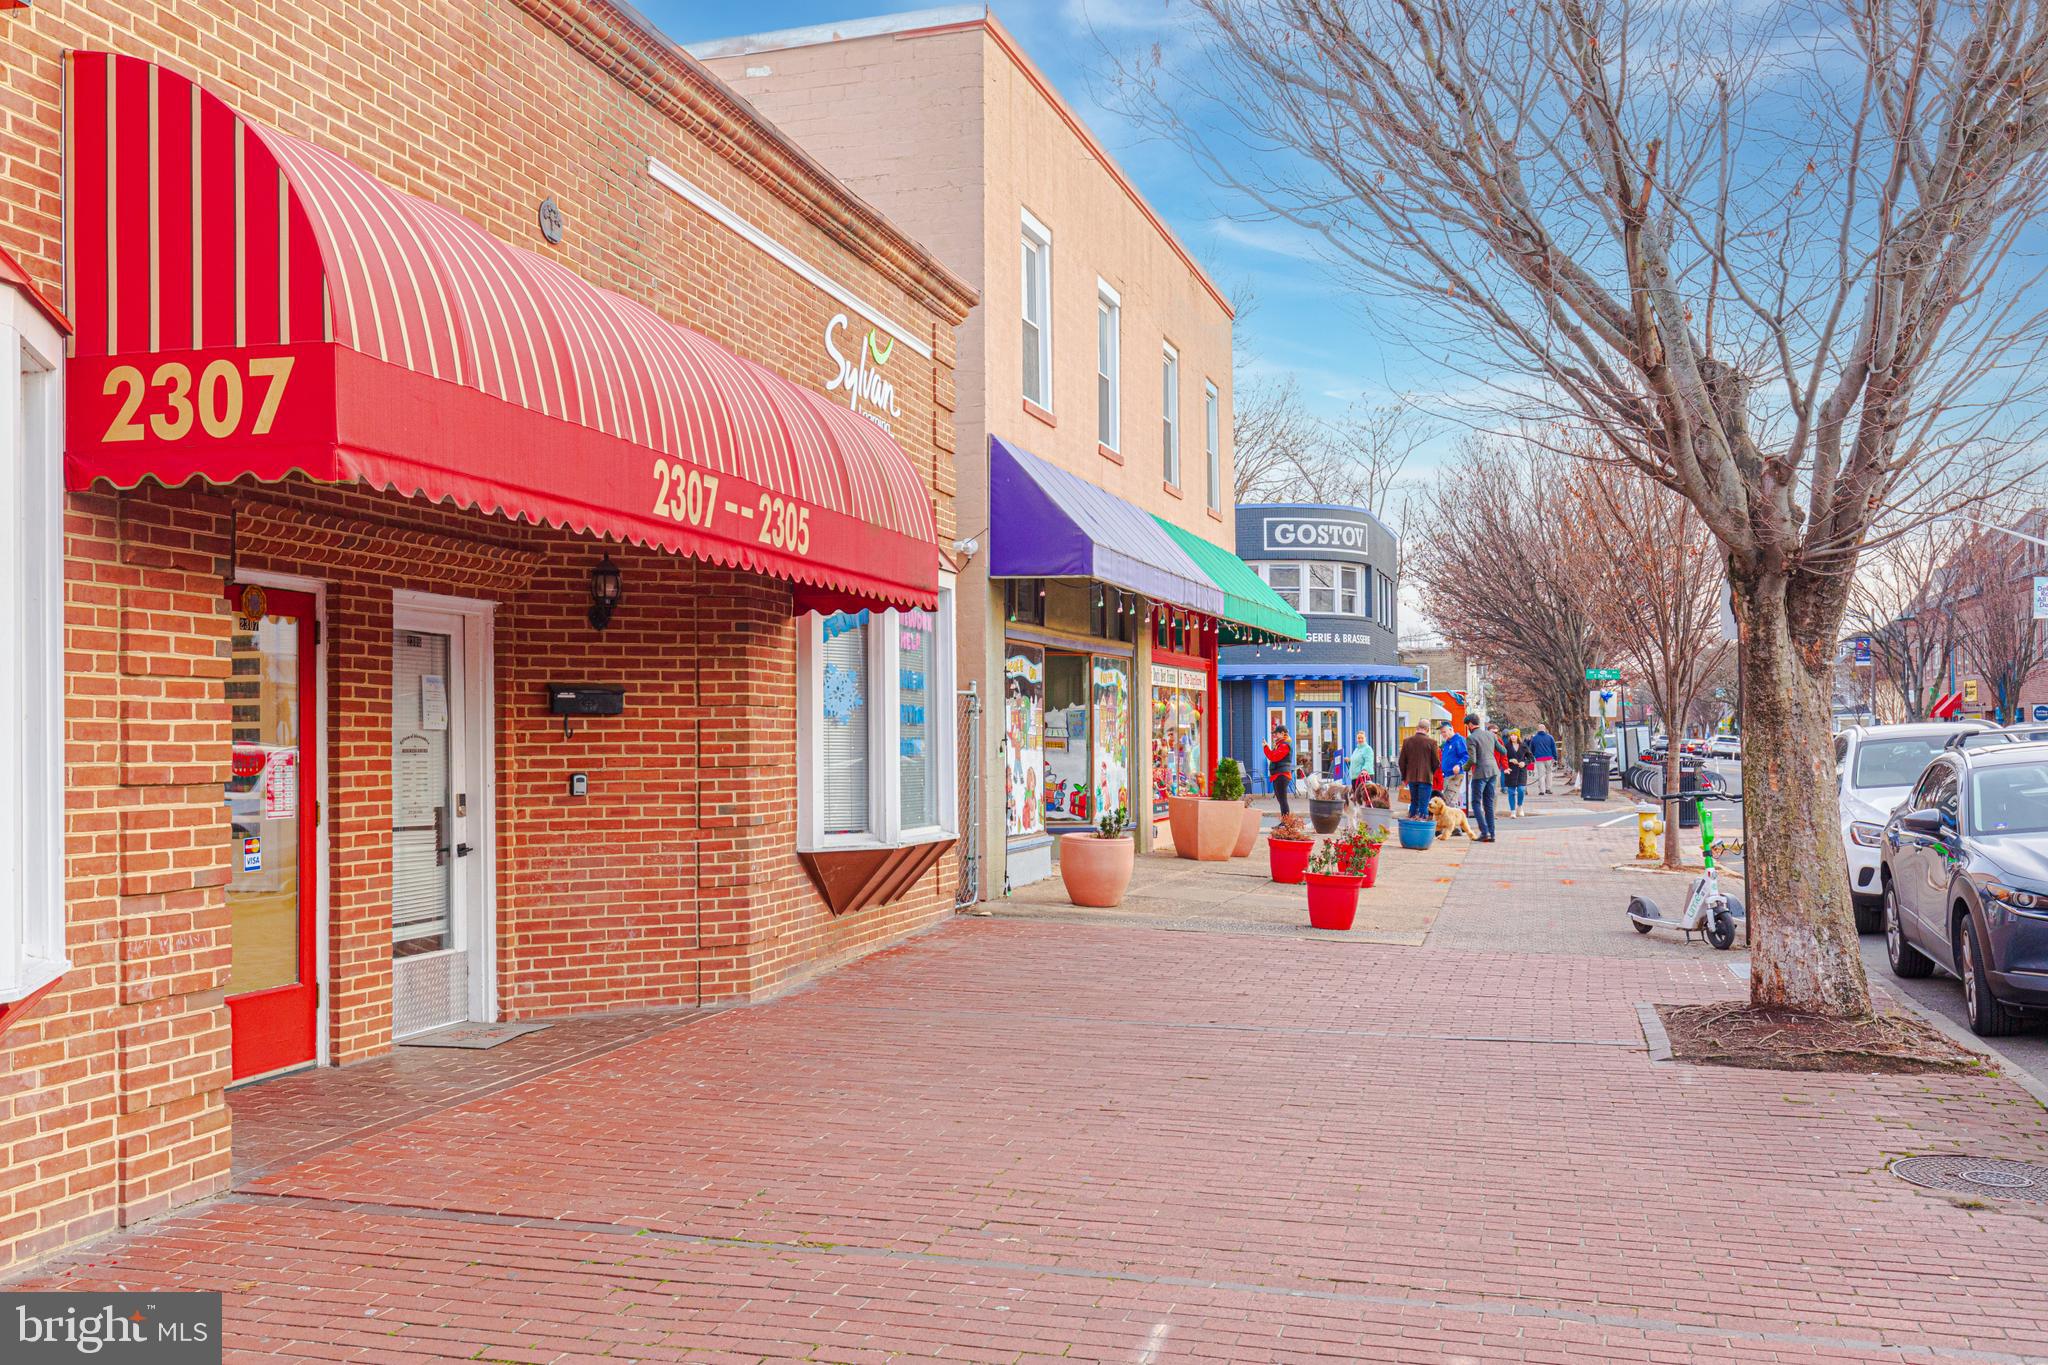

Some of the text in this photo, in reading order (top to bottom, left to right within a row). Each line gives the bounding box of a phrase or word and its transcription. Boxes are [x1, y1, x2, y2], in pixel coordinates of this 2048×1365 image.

[824, 313, 901, 417] Sylvan
[100, 356, 295, 443] 2307
[652, 458, 720, 528] 2307
[758, 493, 810, 556] 2305
[1274, 523, 1364, 547] GOSTOV
[1334, 633, 1341, 643] &
[1343, 633, 1371, 645] BRASSERIE
[247, 855, 260, 865] VISA
